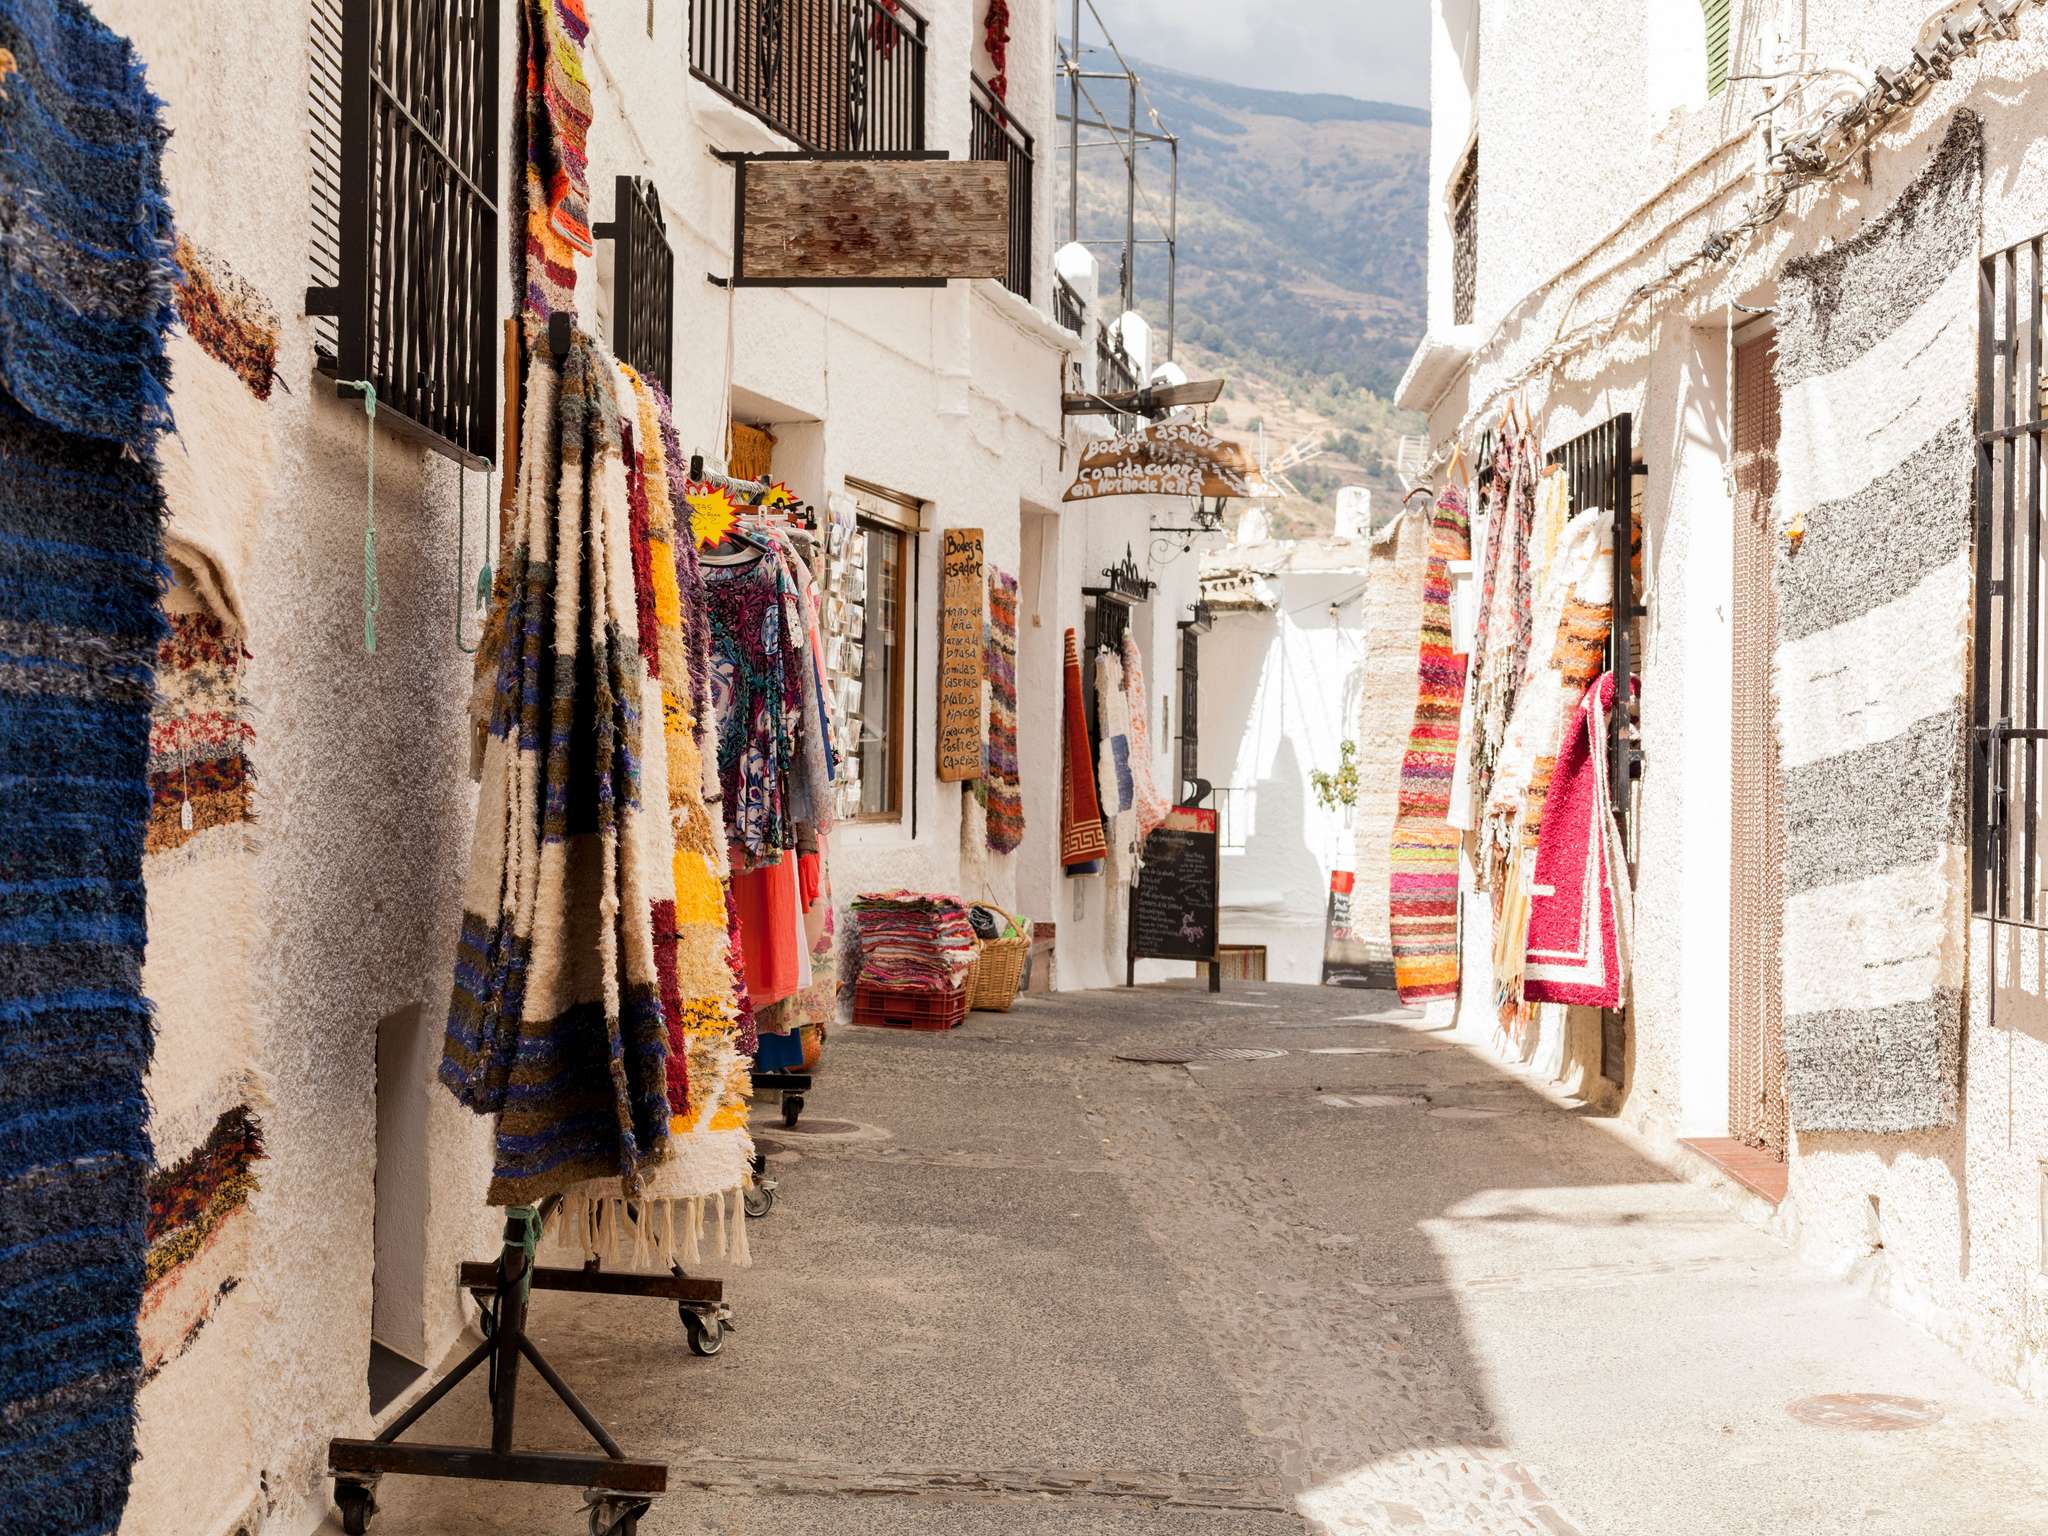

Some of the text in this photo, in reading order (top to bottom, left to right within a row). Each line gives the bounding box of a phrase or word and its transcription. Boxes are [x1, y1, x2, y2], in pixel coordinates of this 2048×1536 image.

[1079, 458, 1144, 481] comida
[1071, 483, 1094, 497] en
[1139, 478, 1158, 492] de
[944, 531, 984, 560] Bodega
[945, 559, 983, 577] asador
[951, 619, 973, 631] leña
[946, 648, 976, 658] brasa
[942, 738, 980, 754] Postres
